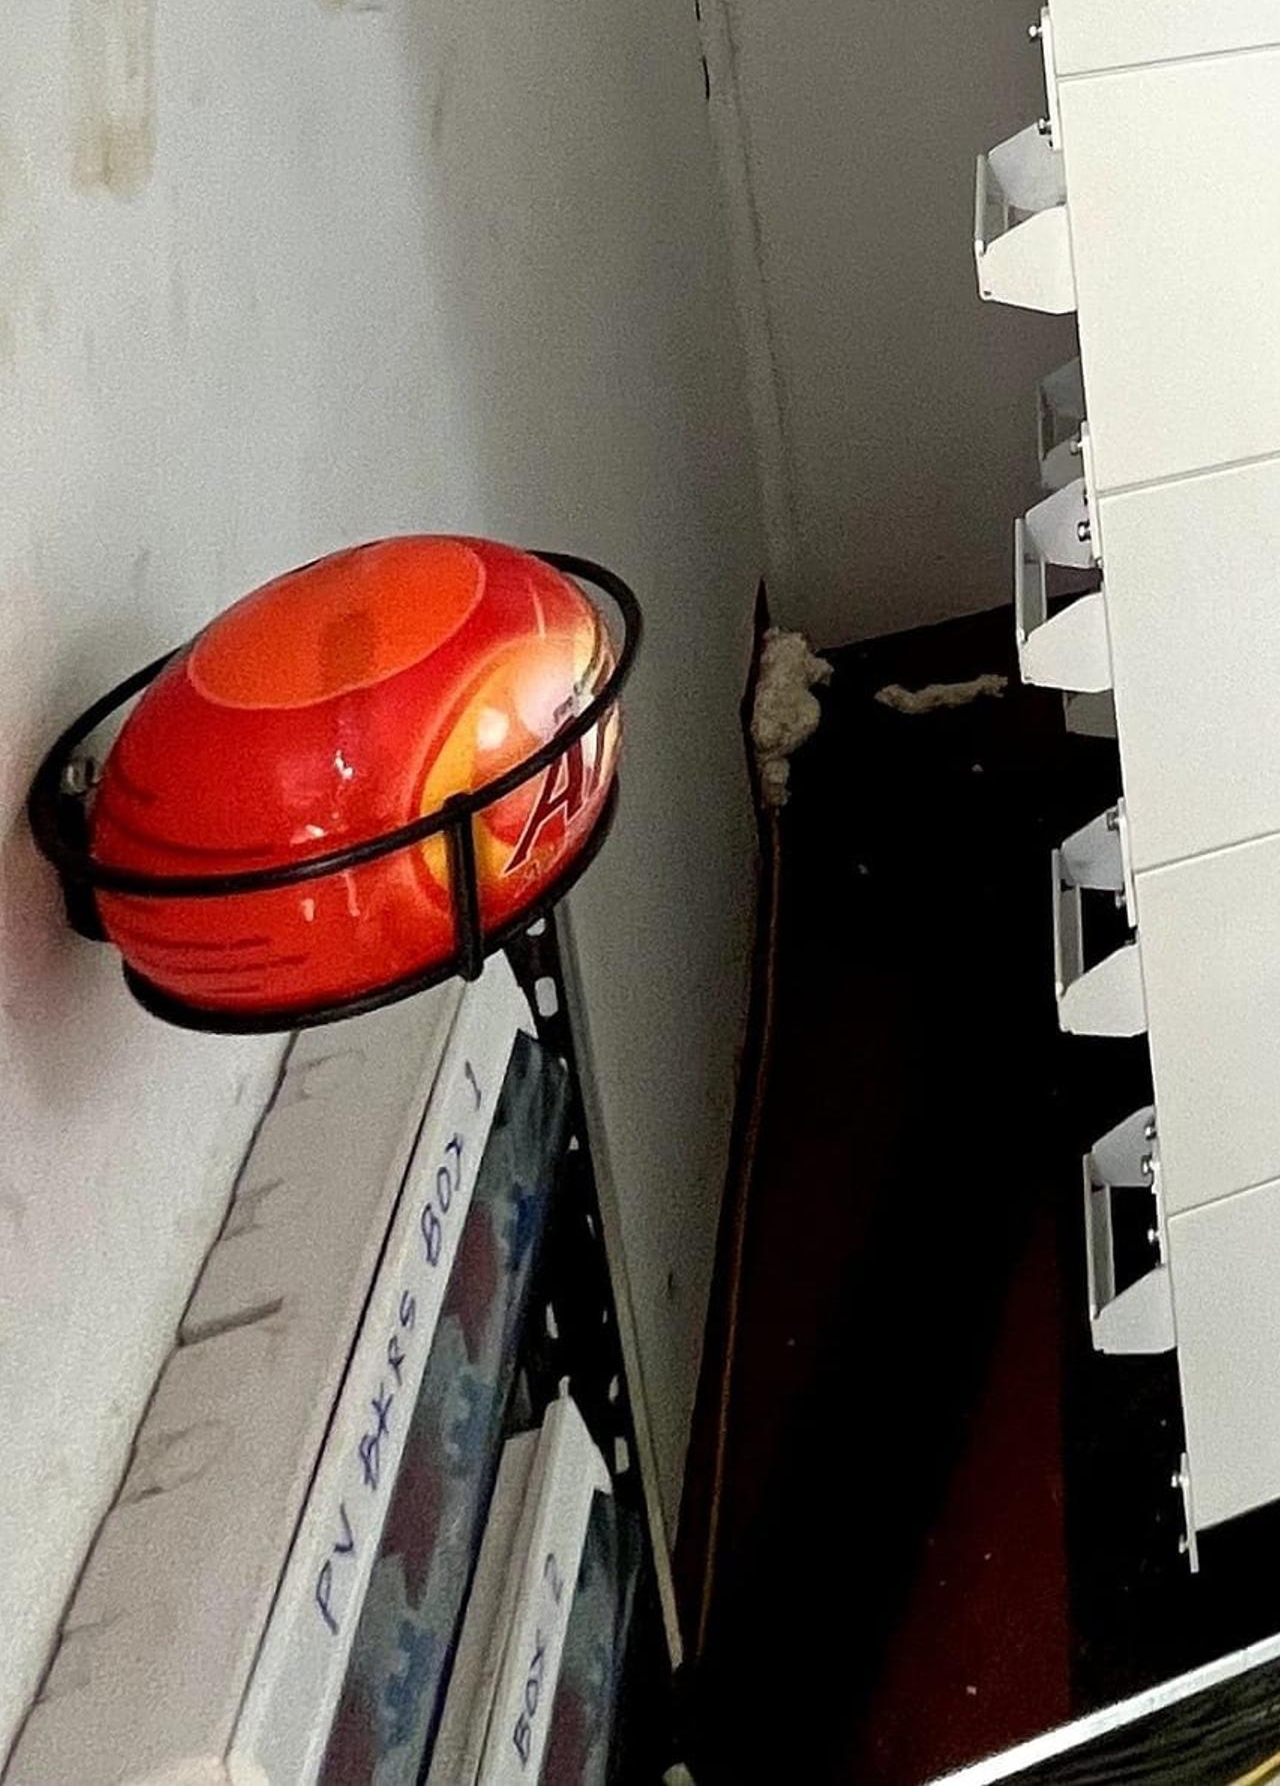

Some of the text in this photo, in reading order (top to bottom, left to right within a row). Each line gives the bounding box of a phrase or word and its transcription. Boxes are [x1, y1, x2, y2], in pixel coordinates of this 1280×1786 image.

[315, 1500, 356, 1636] PV
[420, 1131, 465, 1268] BOX
[513, 1552, 565, 1772] BOX 2
